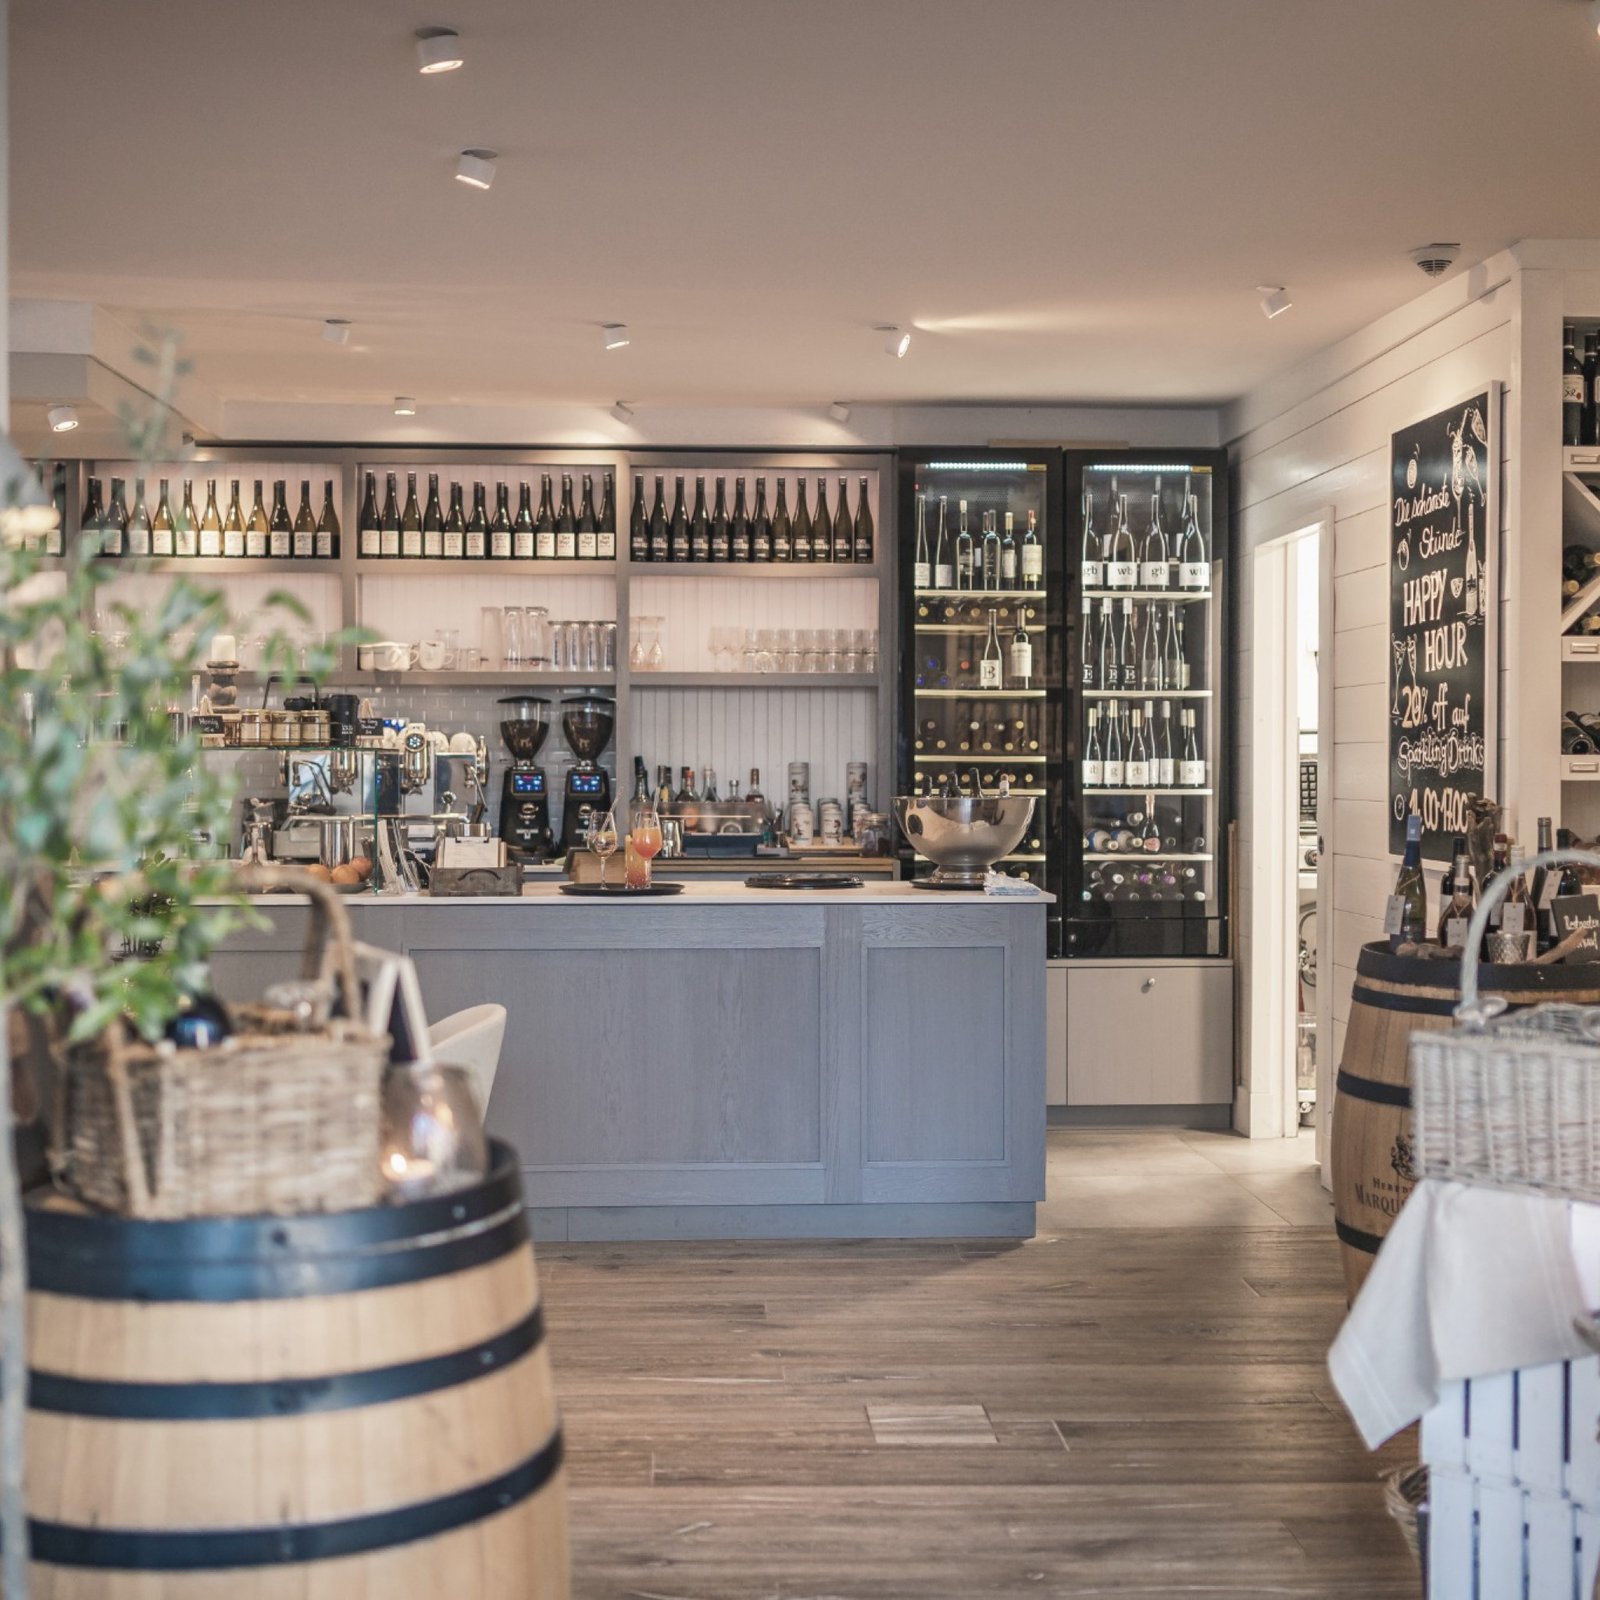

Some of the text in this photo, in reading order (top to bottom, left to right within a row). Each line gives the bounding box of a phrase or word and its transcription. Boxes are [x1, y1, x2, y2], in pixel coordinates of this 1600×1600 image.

[1395, 497, 1410, 527] Die
[1403, 568, 1447, 627] HAPPY
[1424, 621, 1468, 672] HOUR
[1402, 682, 1471, 733] 20% off auf
[1398, 731, 1484, 786] Sparkling Drinks
[1354, 1183, 1405, 1217] MARQU
